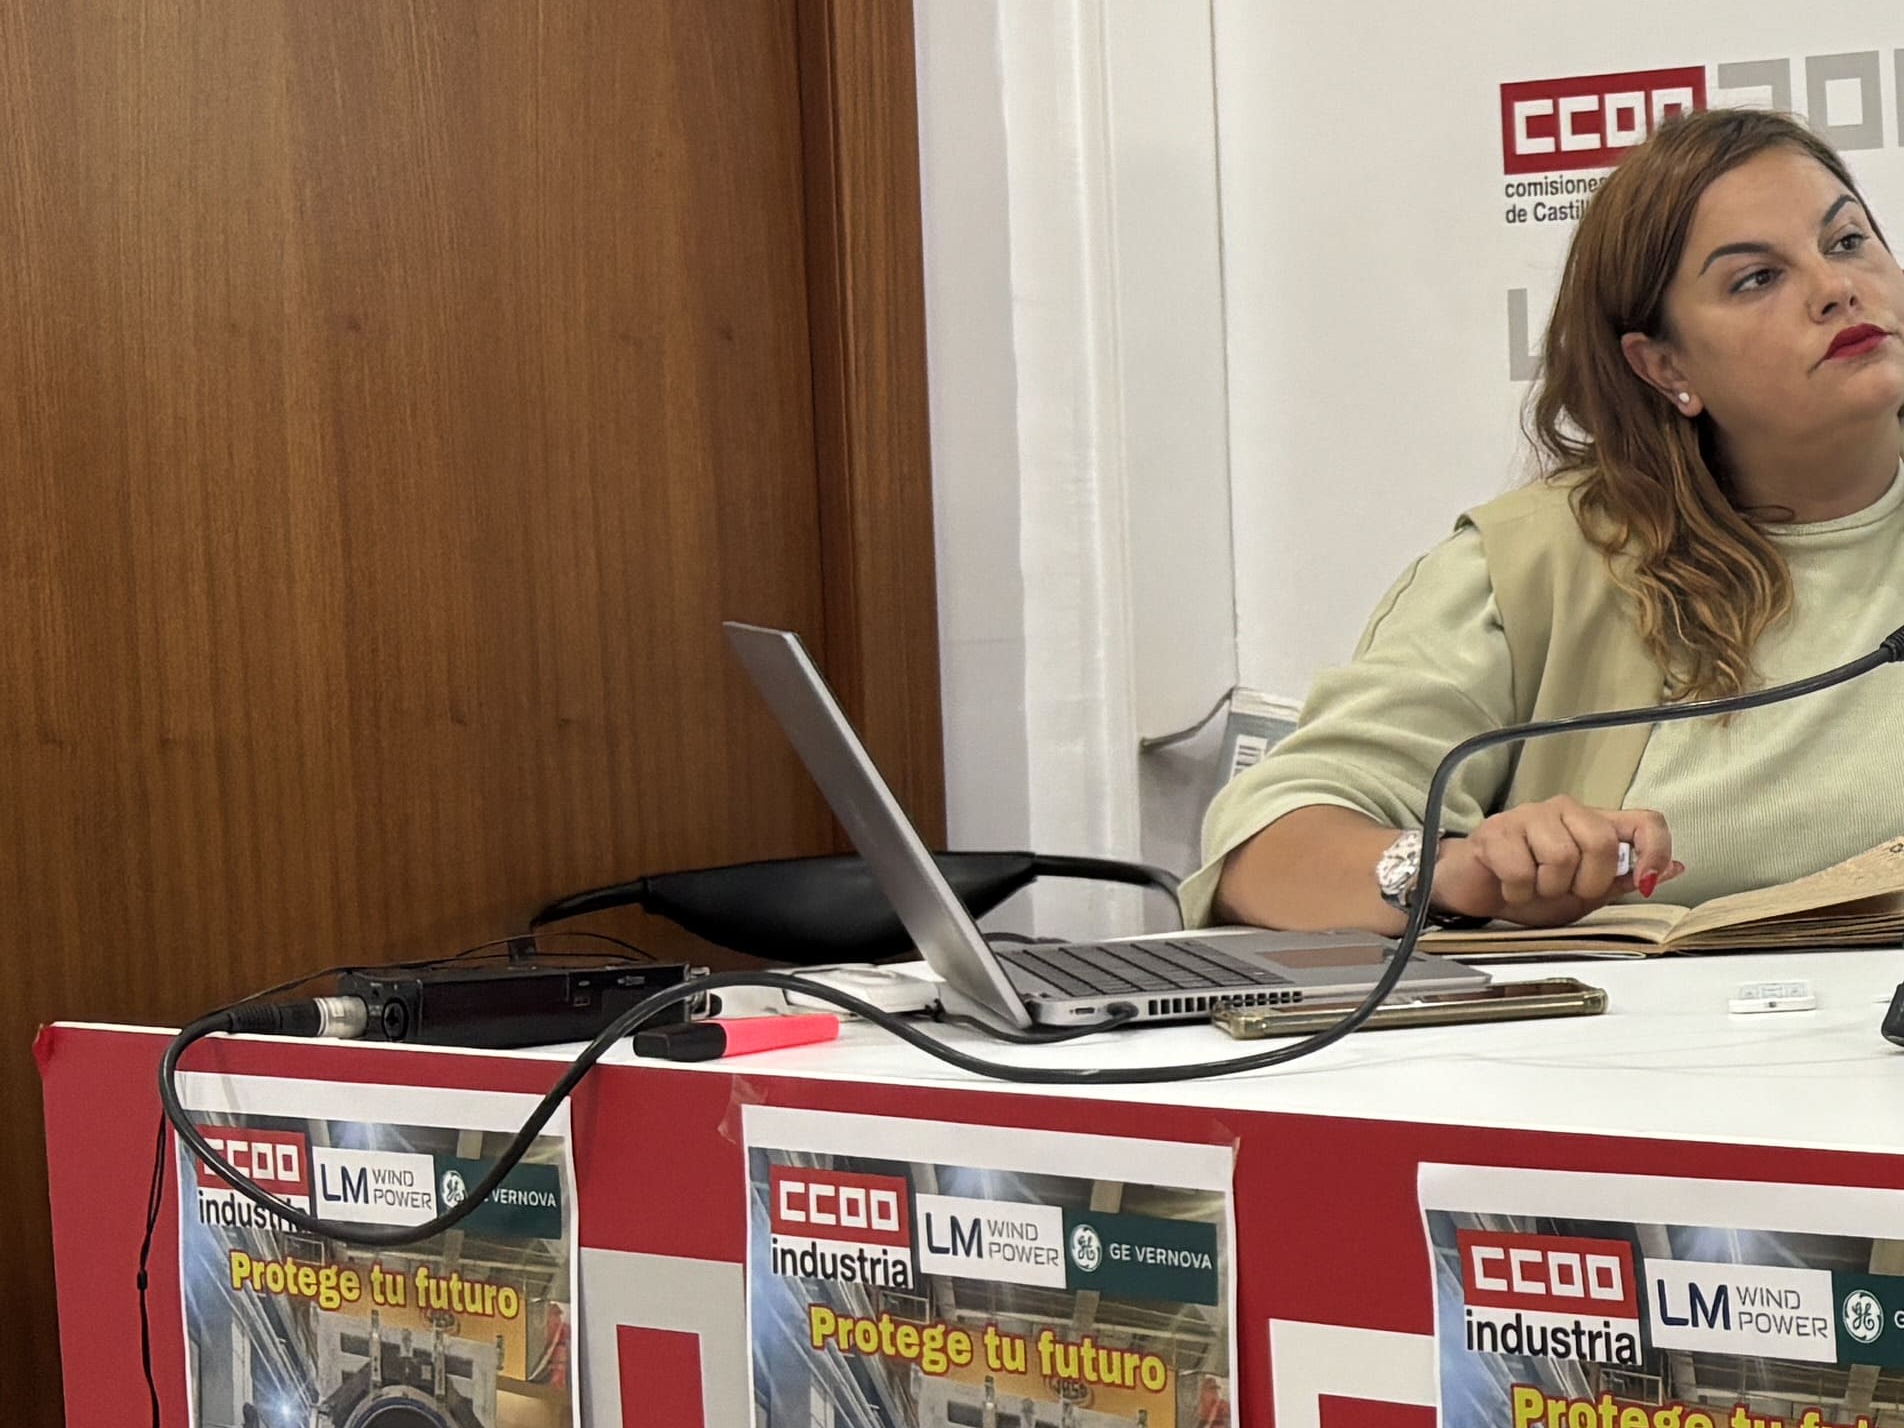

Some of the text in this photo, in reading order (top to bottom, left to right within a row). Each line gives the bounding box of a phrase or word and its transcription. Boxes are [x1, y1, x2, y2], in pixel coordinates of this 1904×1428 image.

[1506, 204, 1528, 224] de
[320, 1164, 369, 1205] LM
[372, 1170, 414, 1187] WIND
[373, 1189, 433, 1210] POWER
[490, 1188, 557, 1208] VERNOVA
[779, 1180, 898, 1230] CCOO
[924, 1212, 984, 1261] LM
[987, 1219, 1039, 1242] WIND
[771, 1238, 909, 1289] industria
[988, 1243, 1060, 1267] POWER
[1109, 1242, 1213, 1270] GE VERNOVA
[229, 1249, 520, 1319] Protege tu futuro
[1470, 1245, 1625, 1302] CCOO
[1657, 1278, 1732, 1331] LM
[1736, 1285, 1801, 1311] WIND
[1466, 1308, 1638, 1365] industria
[1737, 1312, 1829, 1340] POWER
[809, 1304, 1168, 1393] Protege tu futuro
